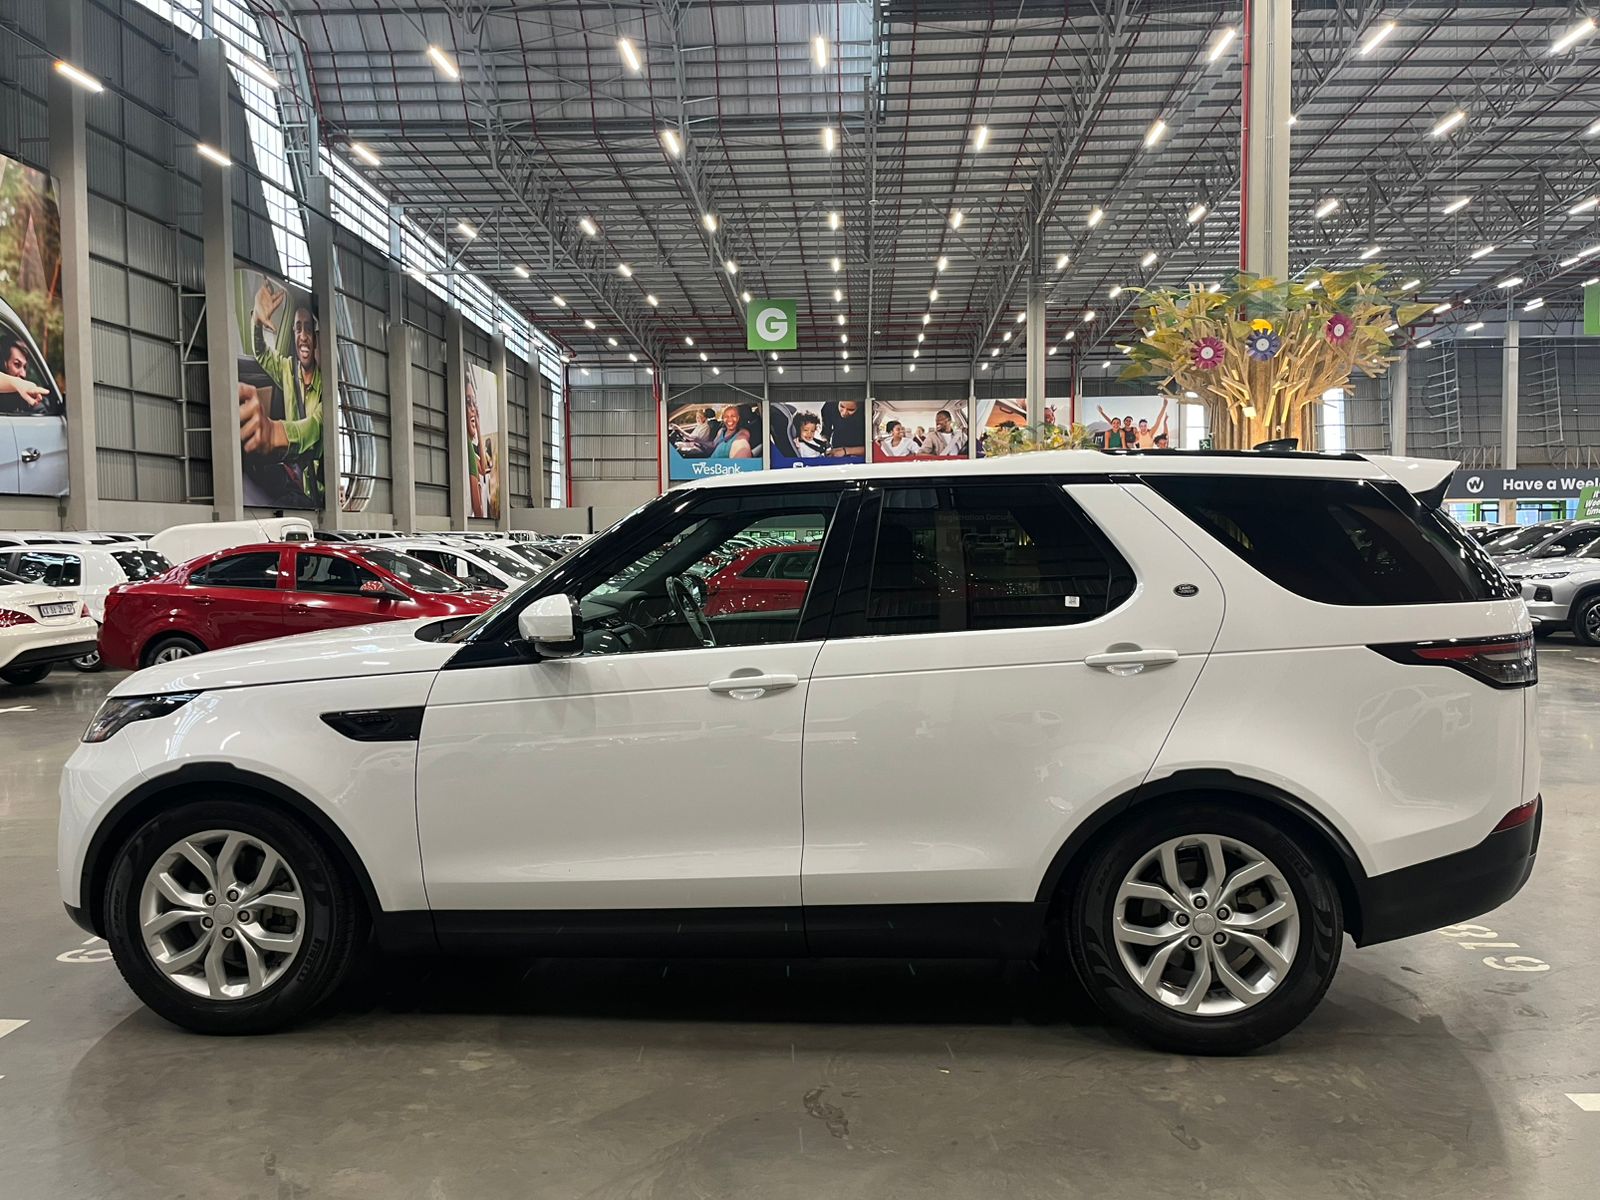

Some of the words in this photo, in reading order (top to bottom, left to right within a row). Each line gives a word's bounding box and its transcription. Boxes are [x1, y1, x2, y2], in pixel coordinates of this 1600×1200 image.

[755, 307, 788, 342] G
[692, 462, 741, 475] WesBank
[1503, 478, 1543, 490] Have
[1546, 480, 1557, 490] a
